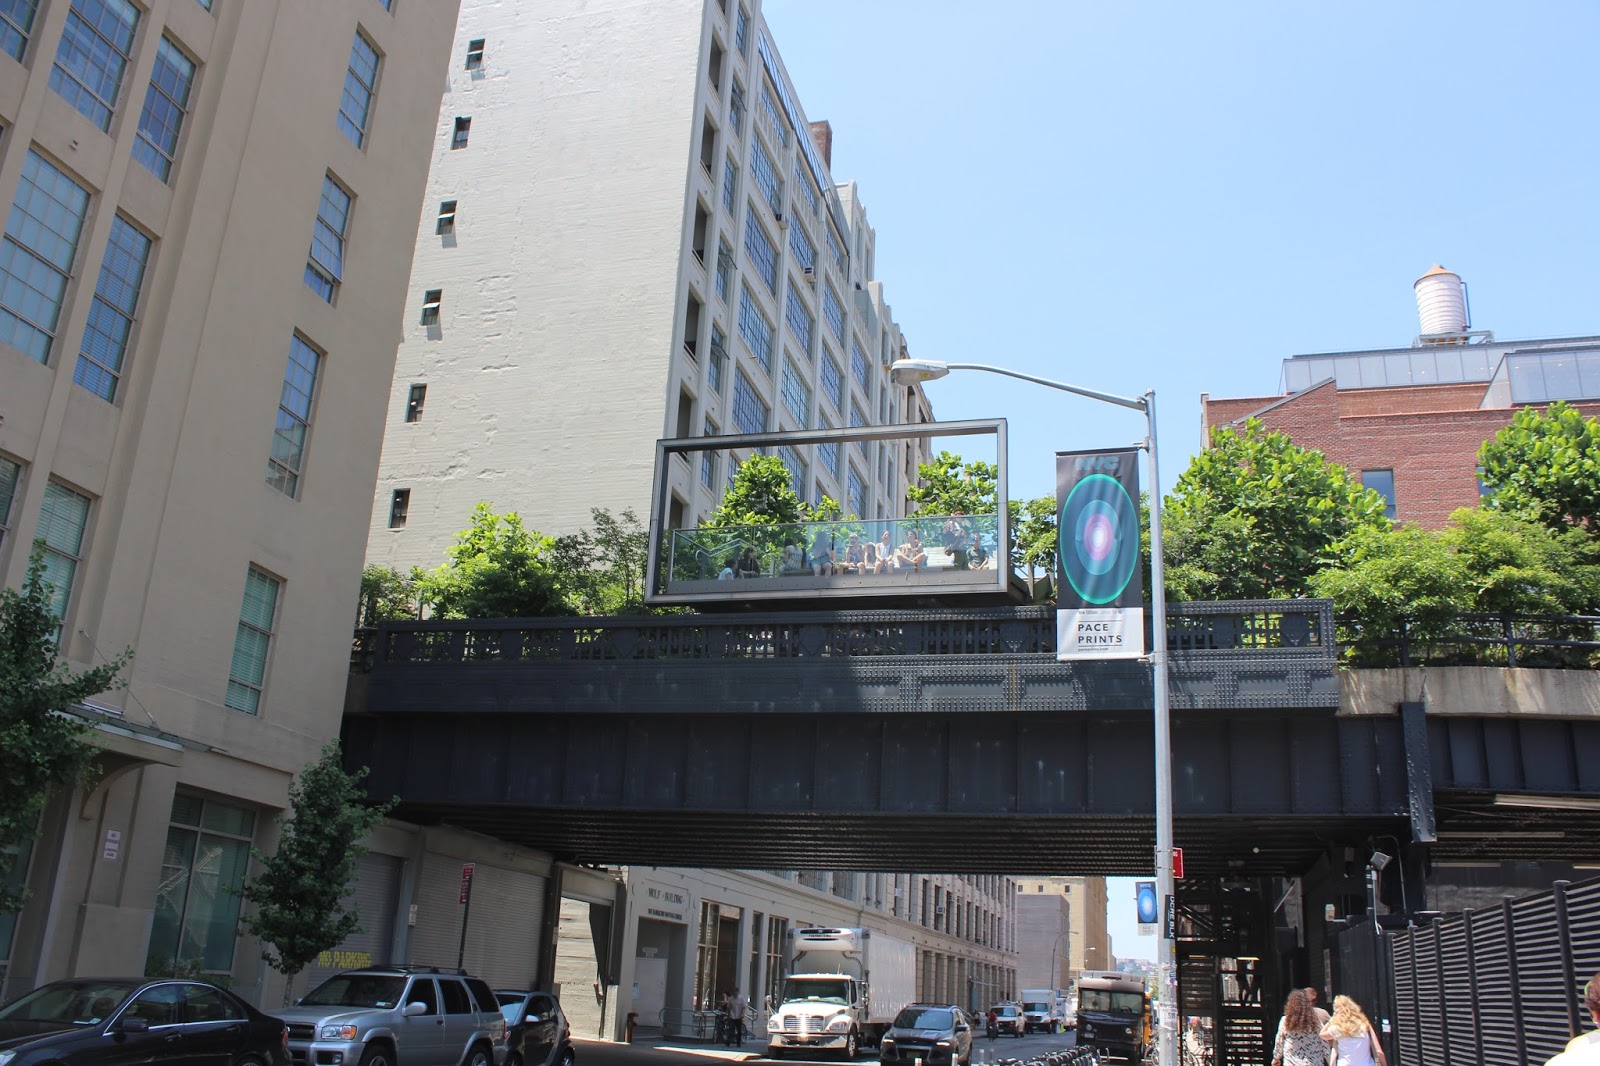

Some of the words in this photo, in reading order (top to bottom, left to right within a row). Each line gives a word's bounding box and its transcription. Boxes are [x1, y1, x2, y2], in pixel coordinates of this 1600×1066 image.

[1074, 456, 1119, 471] NYC
[1078, 623, 1109, 632] PACE
[1078, 635, 1122, 644] PRINTS
